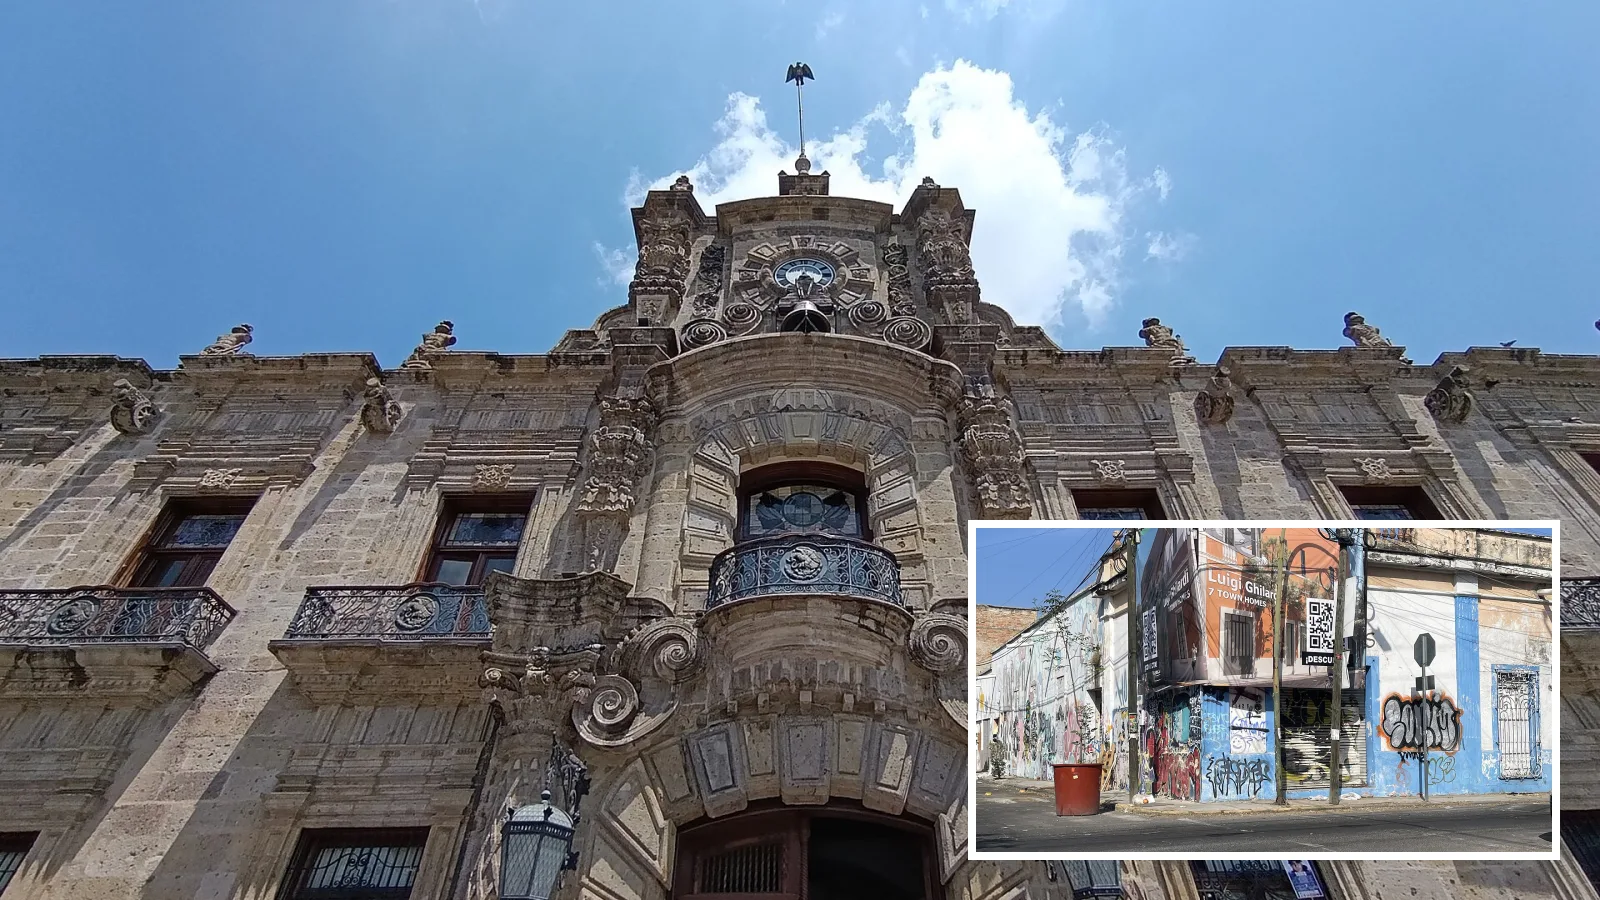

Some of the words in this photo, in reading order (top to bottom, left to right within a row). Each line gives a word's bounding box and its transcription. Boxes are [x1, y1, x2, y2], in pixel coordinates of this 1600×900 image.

[1208, 570, 1241, 591] Luigi
[1217, 589, 1243, 601] TOWN
[1244, 597, 1267, 607] HOMES
[1305, 655, 1334, 664] ¡DESCU
